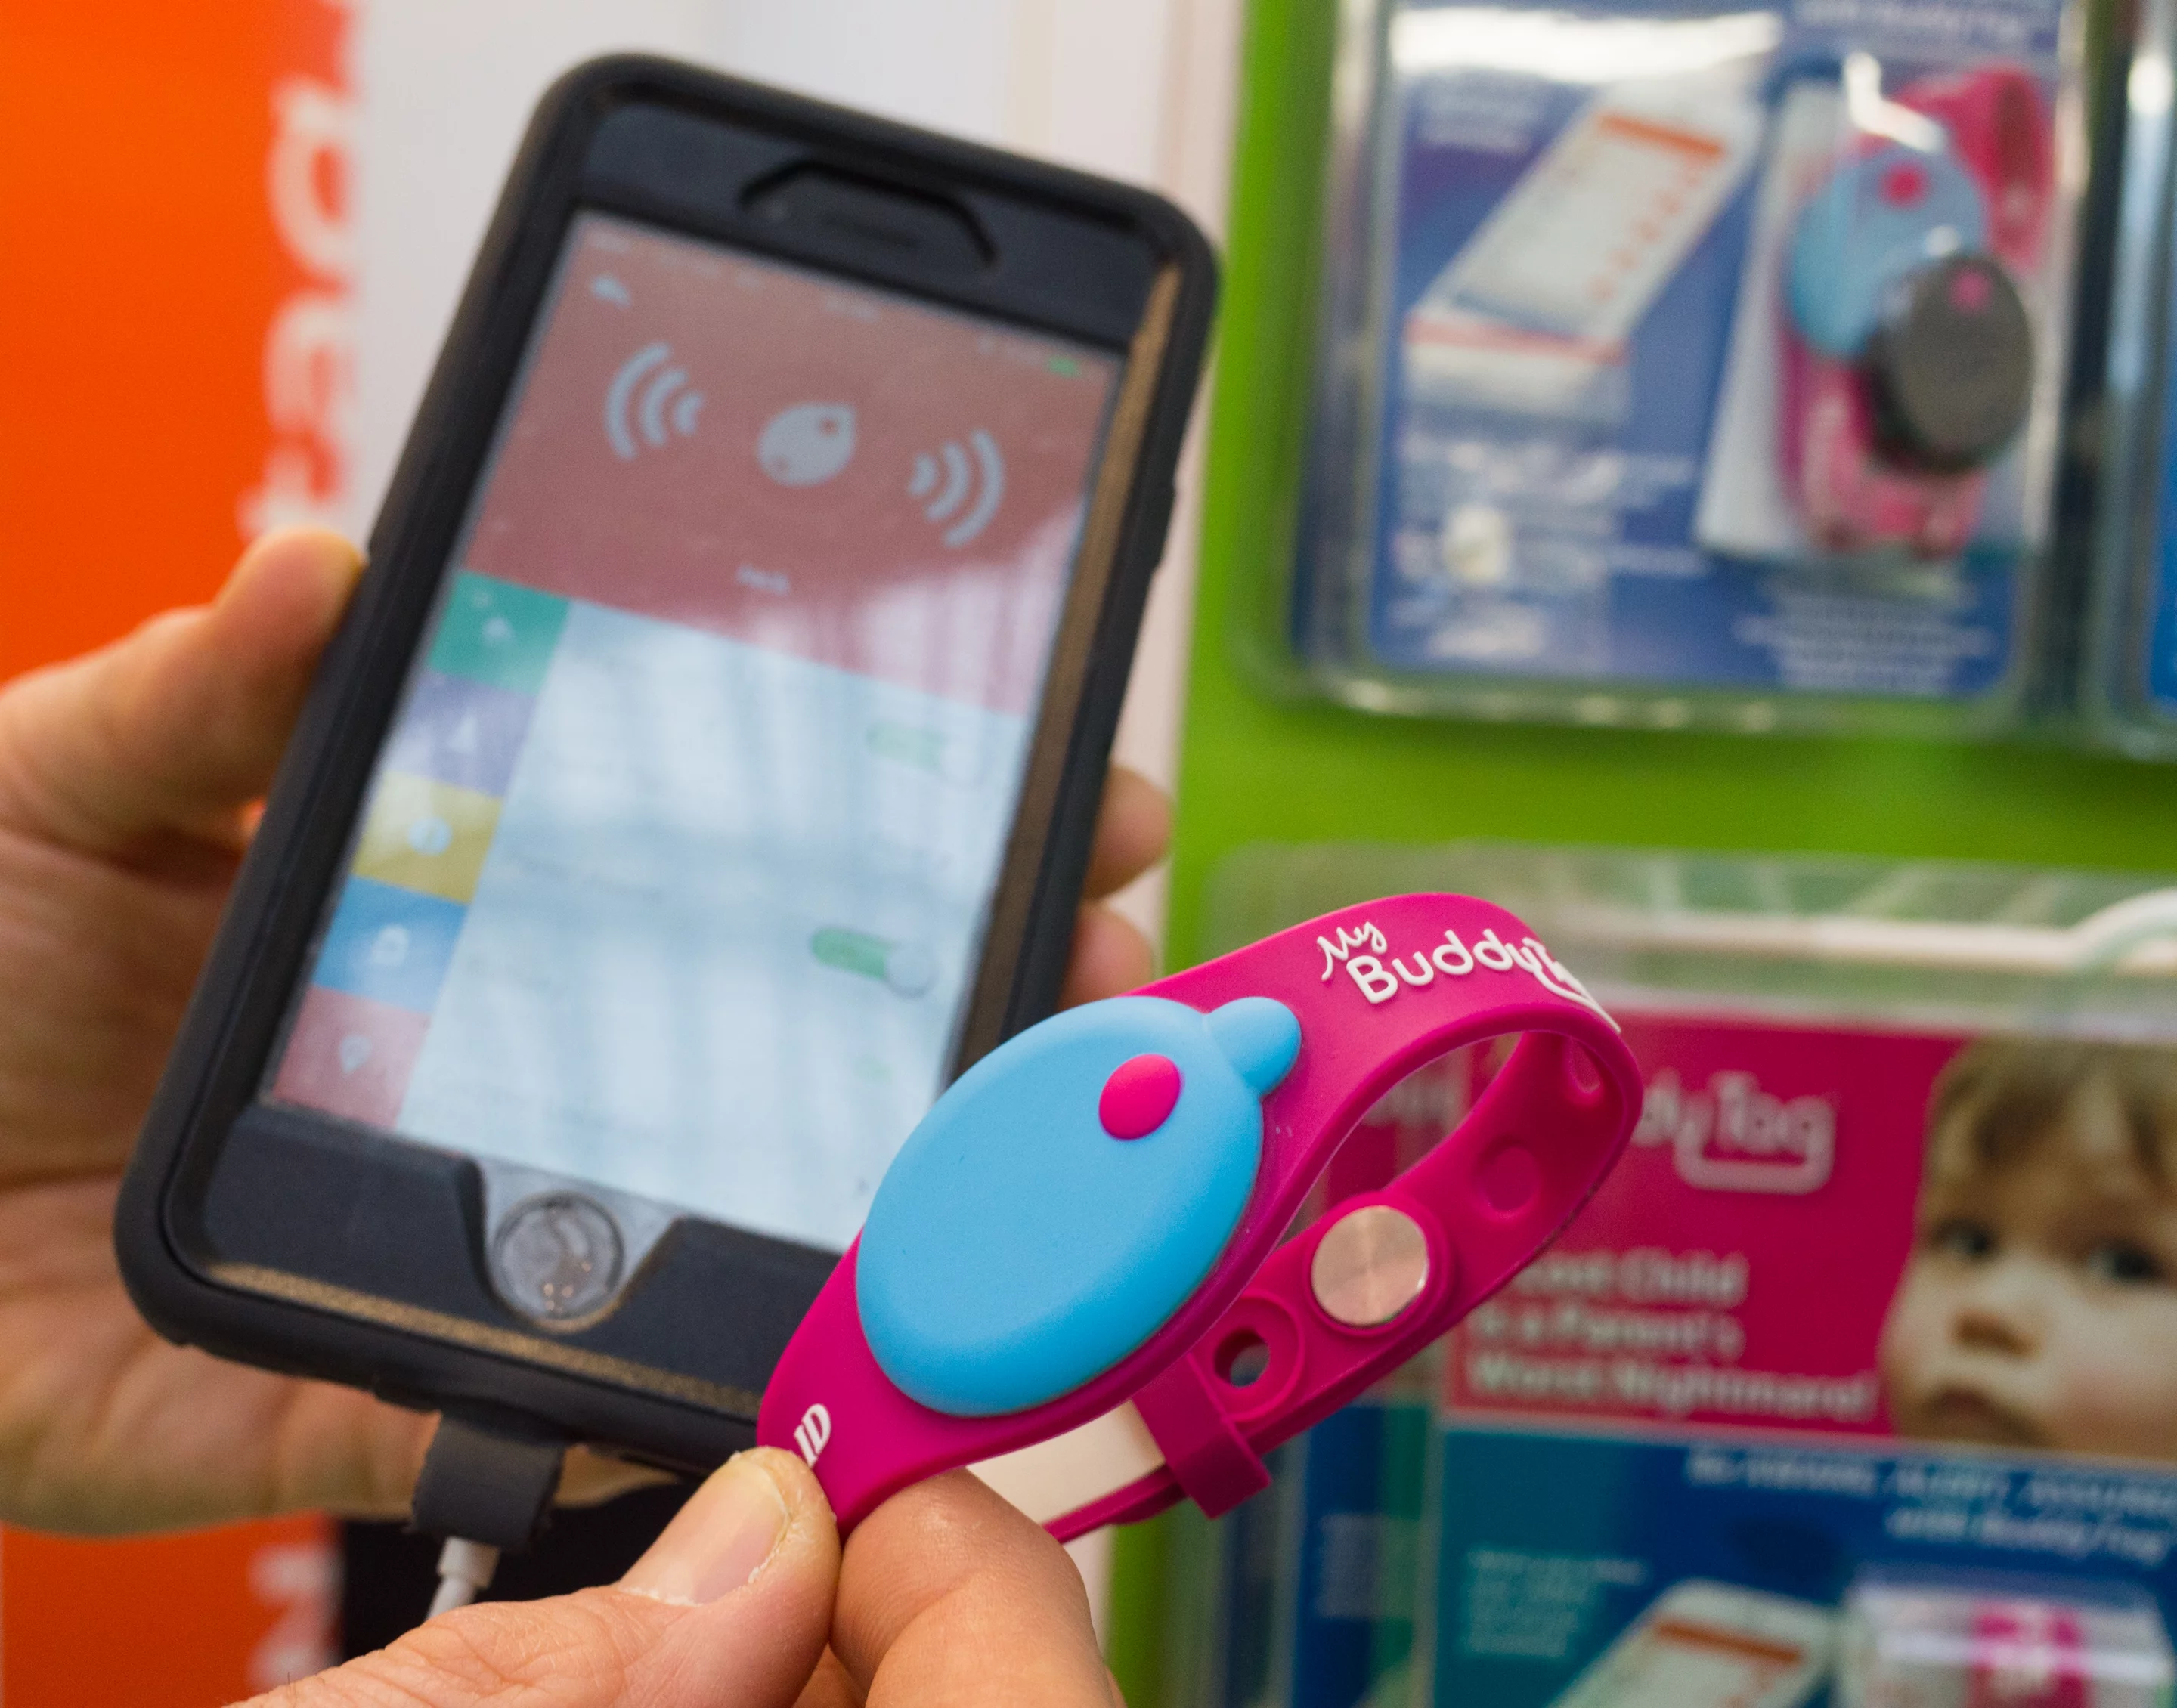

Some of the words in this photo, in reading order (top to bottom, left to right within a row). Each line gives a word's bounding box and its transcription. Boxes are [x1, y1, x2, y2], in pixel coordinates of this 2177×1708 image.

[1316, 921, 1388, 982] My
[1516, 1251, 1614, 1294] ost
[793, 1403, 831, 1468] ID
